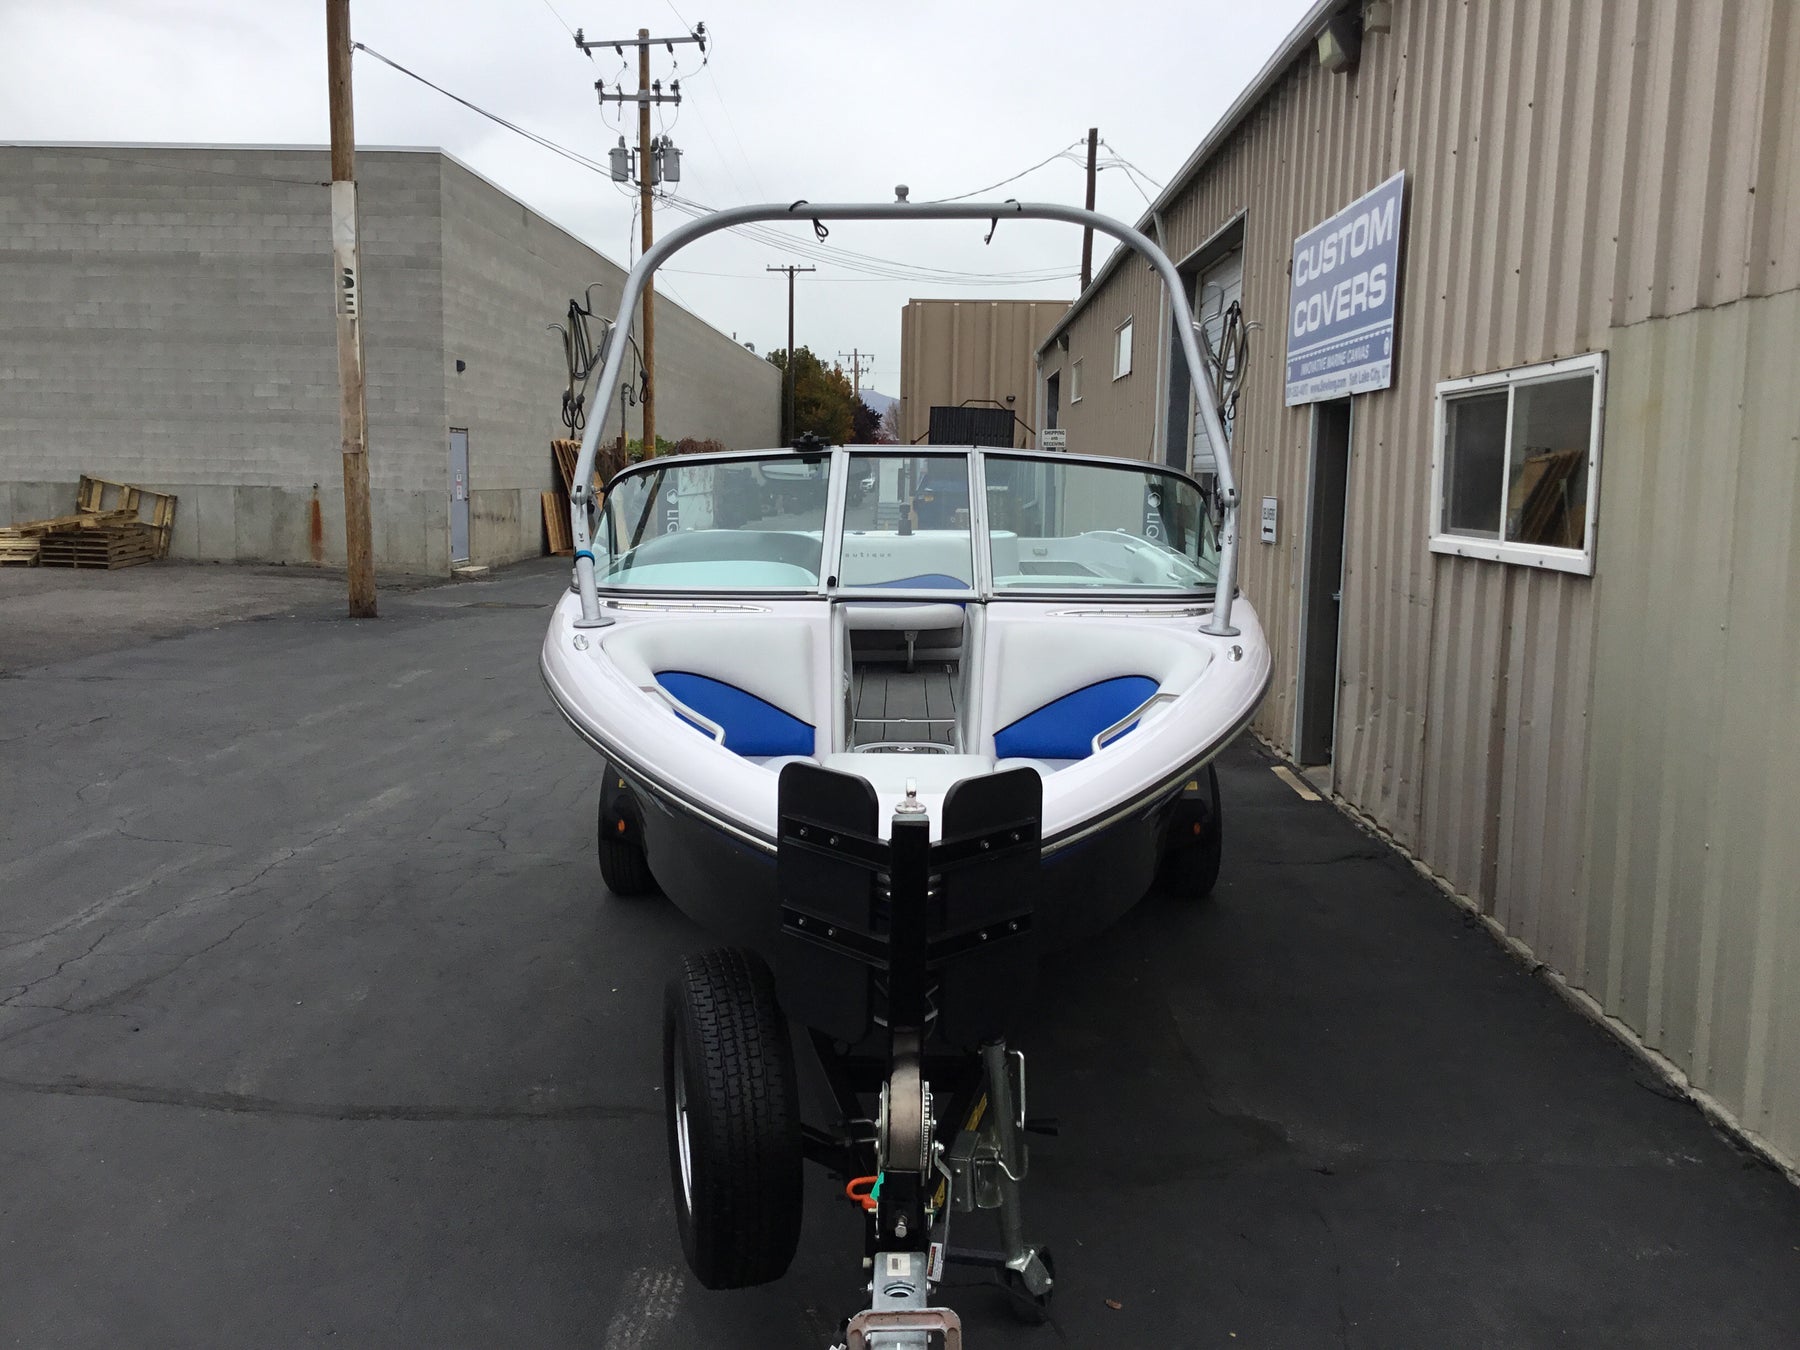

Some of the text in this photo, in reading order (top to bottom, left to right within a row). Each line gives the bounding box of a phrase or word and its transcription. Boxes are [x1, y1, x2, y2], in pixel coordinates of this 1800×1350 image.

[1295, 197, 1395, 286] CUSTOM
[1294, 262, 1388, 338] COVERS
[1327, 350, 1346, 369] MARINE
[1347, 344, 1370, 364] CANVAS
[1359, 369, 1370, 384] Lake
[844, 551, 892, 559] autique
